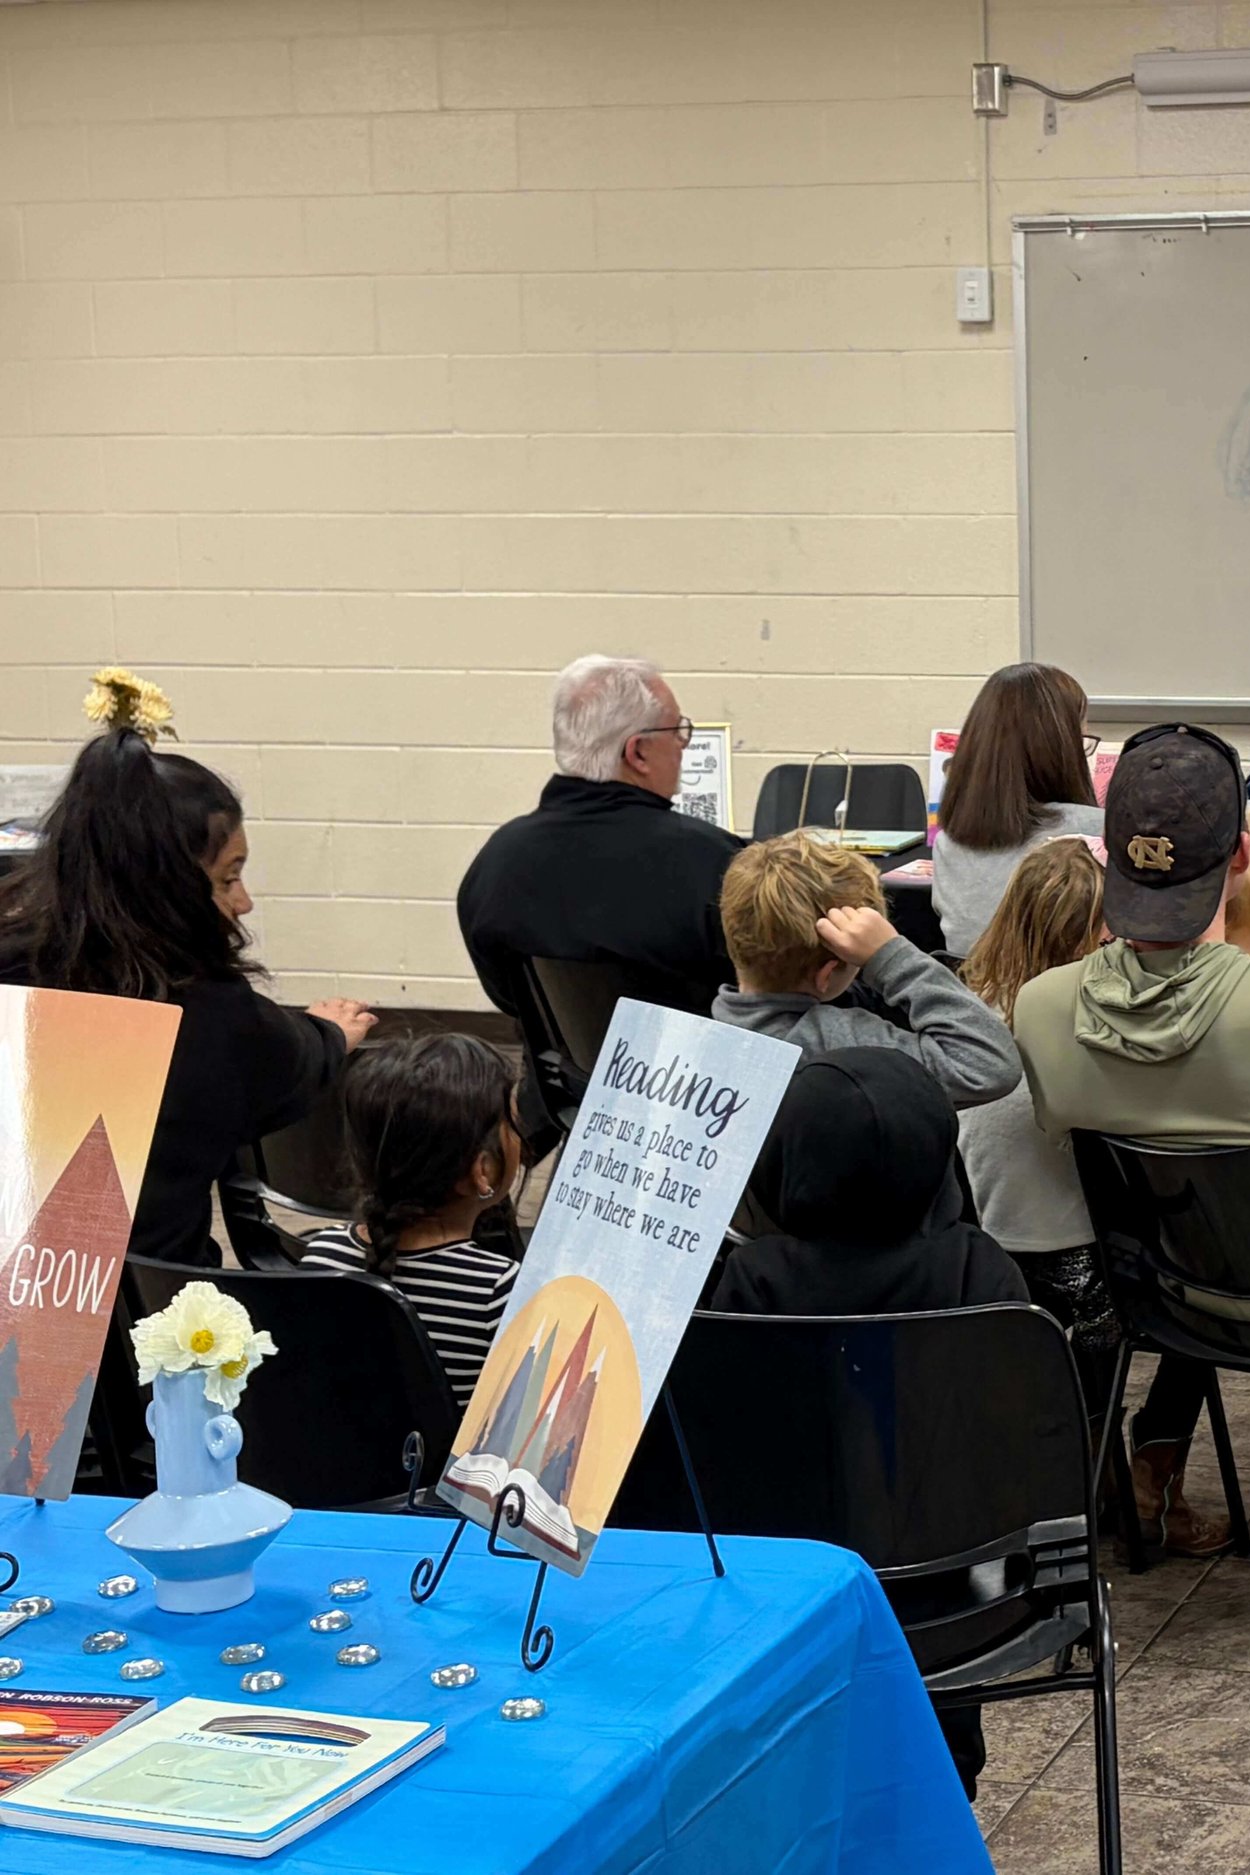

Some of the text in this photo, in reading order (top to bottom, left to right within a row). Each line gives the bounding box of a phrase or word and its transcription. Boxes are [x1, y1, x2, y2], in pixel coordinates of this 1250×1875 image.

[603, 1037, 750, 1139] Reading
[583, 1104, 719, 1171] gives us a place to
[572, 1148, 702, 1209] go when we have
[555, 1181, 701, 1253] to stay where we are
[8, 1243, 116, 1315] GROW
[18, 1693, 133, 1704] ROBSON-ROSS
[176, 1732, 349, 1759] I'm Here For You Now
